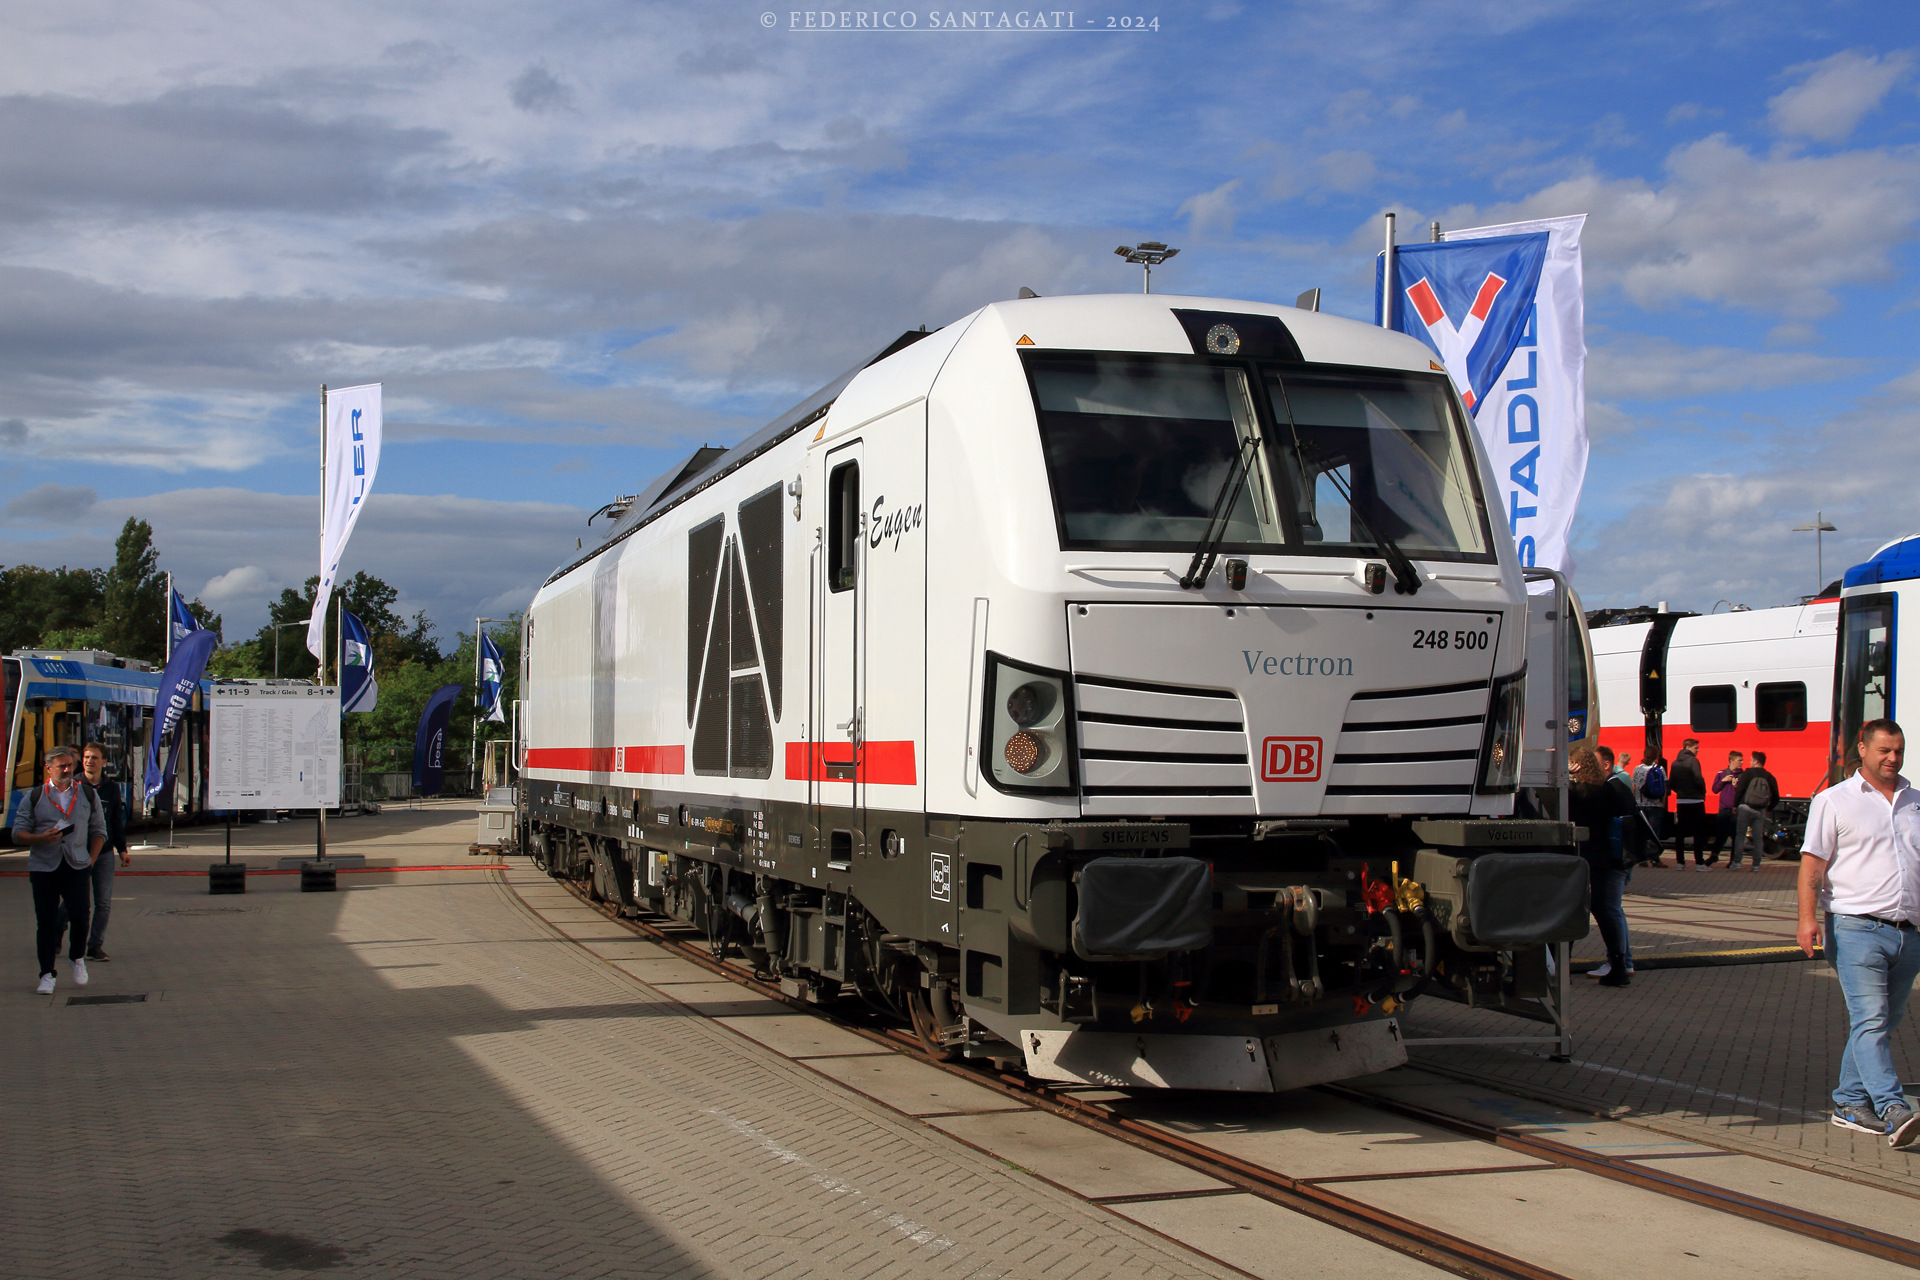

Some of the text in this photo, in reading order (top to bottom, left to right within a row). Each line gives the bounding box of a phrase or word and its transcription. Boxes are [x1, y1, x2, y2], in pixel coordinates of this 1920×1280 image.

[1507, 302, 1540, 568] STADLE
[870, 495, 922, 553] Eugen
[1413, 629, 1489, 650] 248 500
[1242, 650, 1354, 676] Vectron
[1267, 742, 1316, 775] DB
[1102, 830, 1170, 844] SIEMENS
[1488, 829, 1533, 840] Vectron
[934, 869, 943, 883] GC
